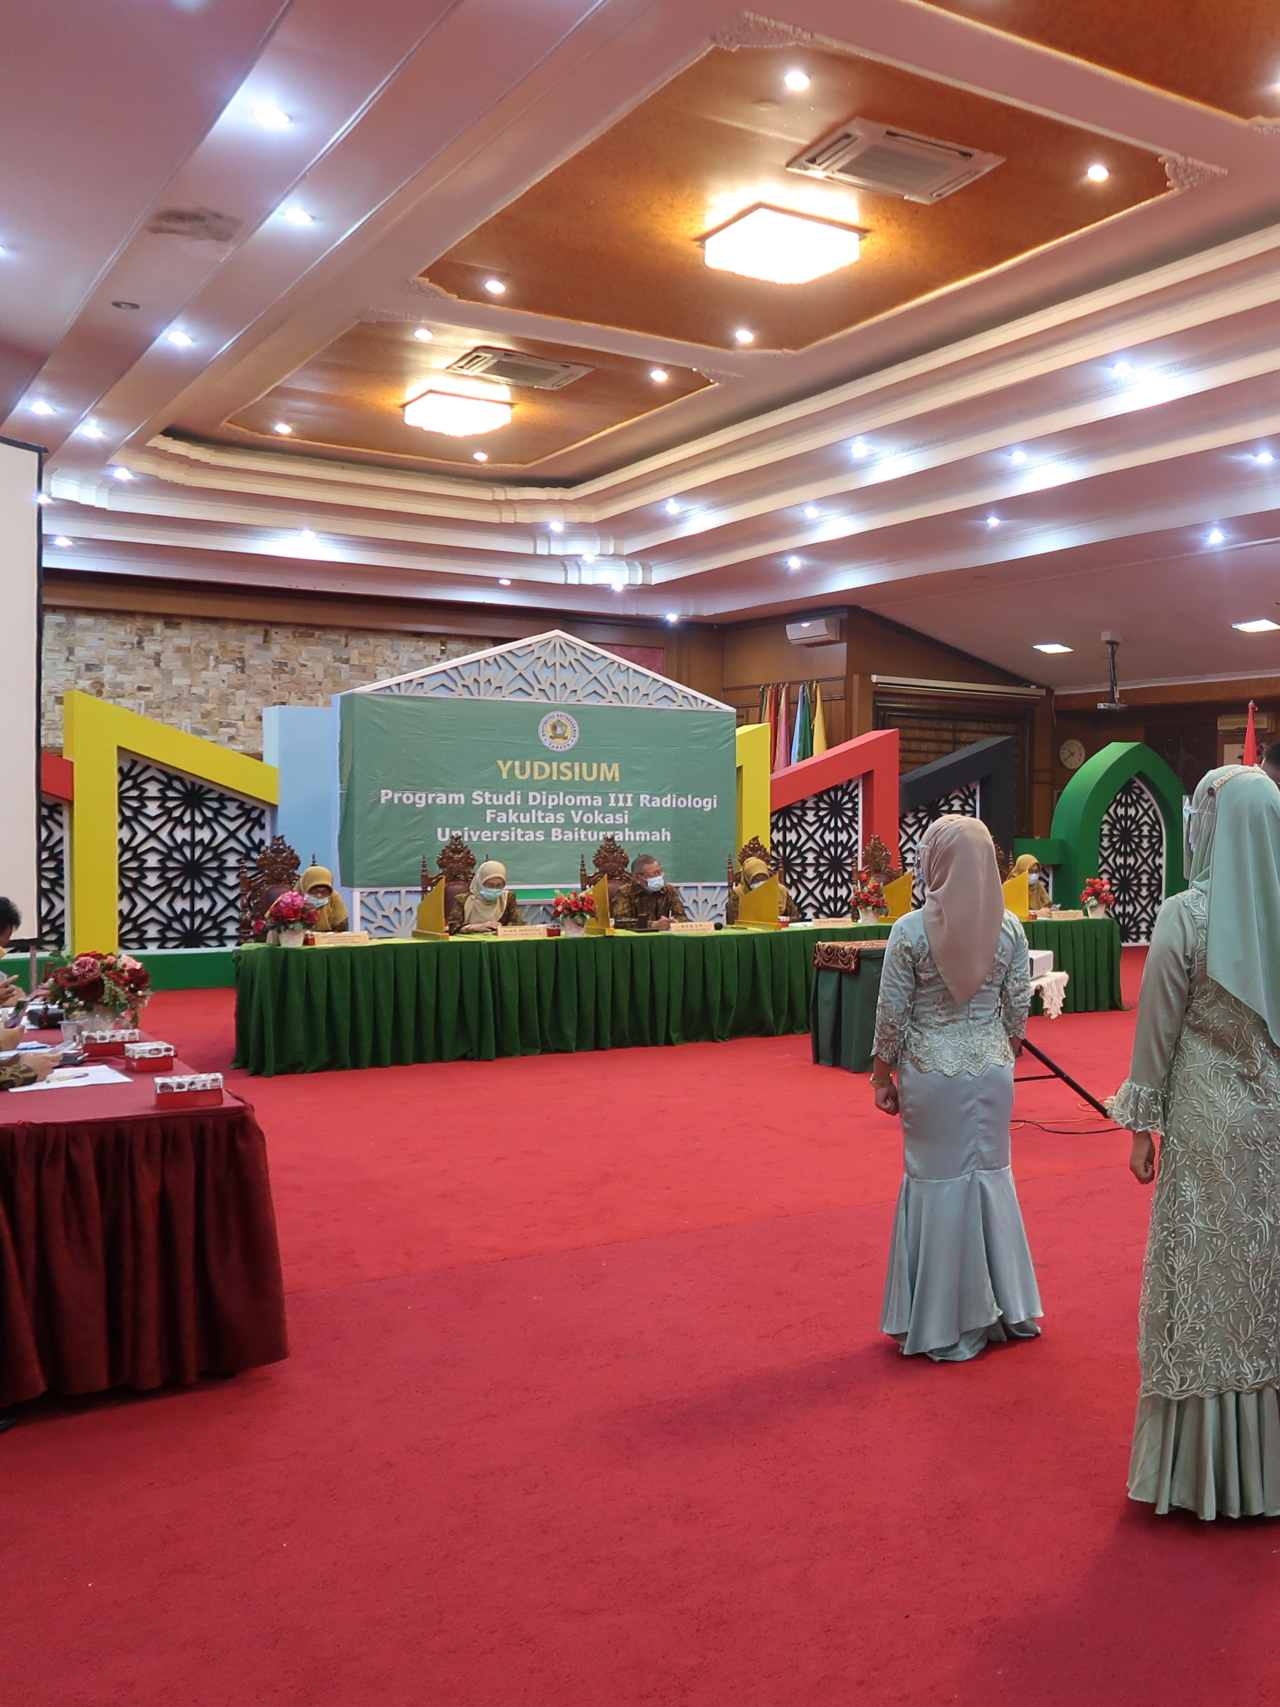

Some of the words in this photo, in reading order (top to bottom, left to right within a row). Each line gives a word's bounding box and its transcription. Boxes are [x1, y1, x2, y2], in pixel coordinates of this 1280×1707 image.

[497, 760, 620, 782] YUDISIUM
[380, 789, 465, 807] Program
[471, 790, 521, 805] Studi
[528, 791, 602, 809] Diploma
[608, 793, 633, 807] III
[639, 793, 718, 811] Radiologi
[485, 808, 565, 824] Fakultas
[570, 809, 629, 824] Vokasi
[437, 826, 545, 842] Universitas
[551, 827, 671, 842] Baiturrahmah
